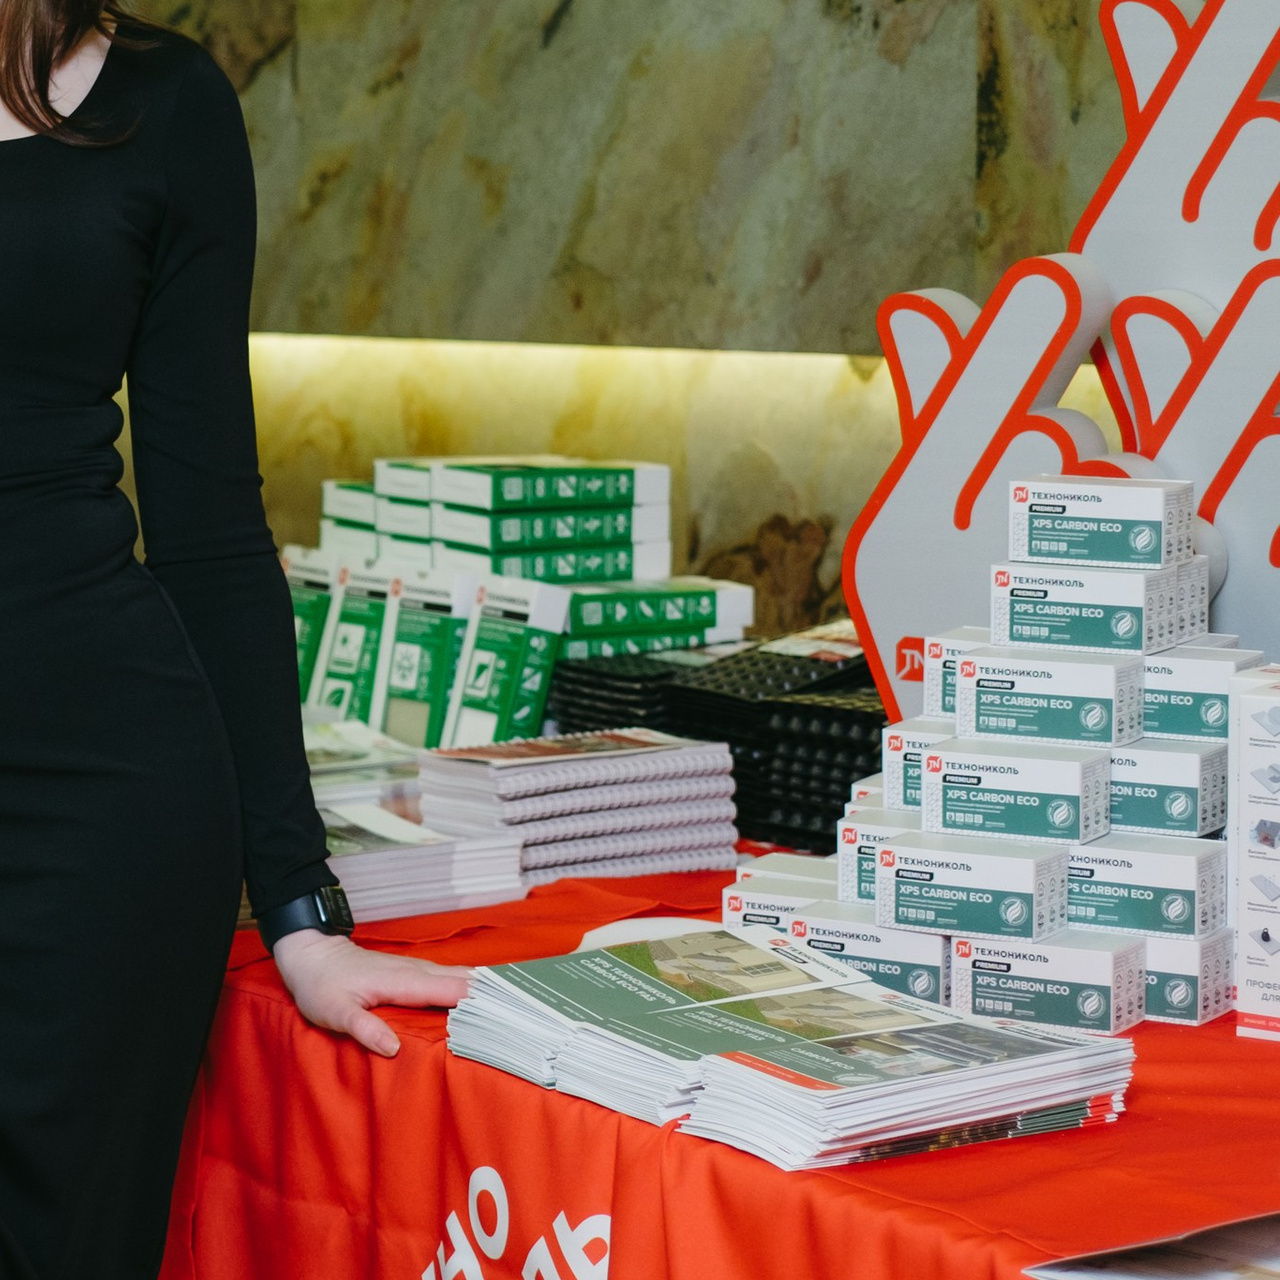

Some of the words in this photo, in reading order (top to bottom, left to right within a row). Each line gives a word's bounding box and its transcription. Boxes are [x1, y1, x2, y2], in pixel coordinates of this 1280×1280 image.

[1031, 492, 1103, 503] ТЕХНОНИКОЛЬ
[1032, 505, 1063, 513] PREMIUM
[1032, 519, 1052, 529] XPS
[1054, 521, 1098, 532] CARBON
[1100, 523, 1122, 533] ECO
[1013, 576, 1084, 588] ТЕХНОНИКОЛЬ
[1013, 590, 1044, 598] PREMIUM
[1013, 603, 1034, 613] XPS
[1036, 605, 1080, 617] CARBON
[1082, 608, 1104, 618] ECO
[979, 666, 1052, 679] ТЕХНОНИКОЛЬ
[1144, 665, 1173, 675] КОЛЬ
[979, 680, 1012, 689] PREMIUM
[980, 694, 1001, 704] XPS
[1002, 696, 1048, 709] CARBON
[1050, 699, 1073, 710] ECO
[1145, 693, 1168, 703] BON
[1171, 695, 1193, 705] ECO
[945, 761, 1019, 775] ТЕХНОНИКОЛЬ
[1110, 758, 1137, 767] КОЛЬ
[945, 775, 979, 784] PREMIUM
[946, 789, 967, 800] XPS
[969, 792, 1015, 804] CARBON
[1016, 795, 1040, 806] ECO
[1135, 787, 1157, 798] ECO
[898, 856, 972, 872] ТЕХНОНИКОЛЬ
[1069, 855, 1133, 869] ХНОНИКОЛЬ
[898, 871, 931, 881] PREMIUM
[899, 884, 920, 896] XPS
[922, 887, 967, 901] CARBON
[969, 892, 993, 903] ECO
[1082, 884, 1128, 898] CARBON
[1130, 889, 1153, 900] ECO
[745, 901, 796, 913] ТЕХНОНИК
[810, 927, 881, 944] ТЕХНОНИКОЛЬ
[810, 940, 842, 950] PREMIUM
[975, 947, 1049, 963] ТЕХНОНИКОЛЬ
[835, 958, 877, 971] ARBON
[879, 963, 901, 975] ECO
[975, 961, 1008, 972] PREMIUM
[580, 959, 621, 981] CARBON
[616, 979, 638, 992] ECO
[613, 967, 677, 1005] ТЕХНОНИКОЛЬ
[976, 976, 997, 987] XPS
[998, 978, 1045, 992] CARBON
[1046, 983, 1070, 995] ECO
[1245, 979, 1280, 992] ПРОФЕ
[791, 1047, 834, 1065] CARBON
[831, 1061, 854, 1070] ECO
